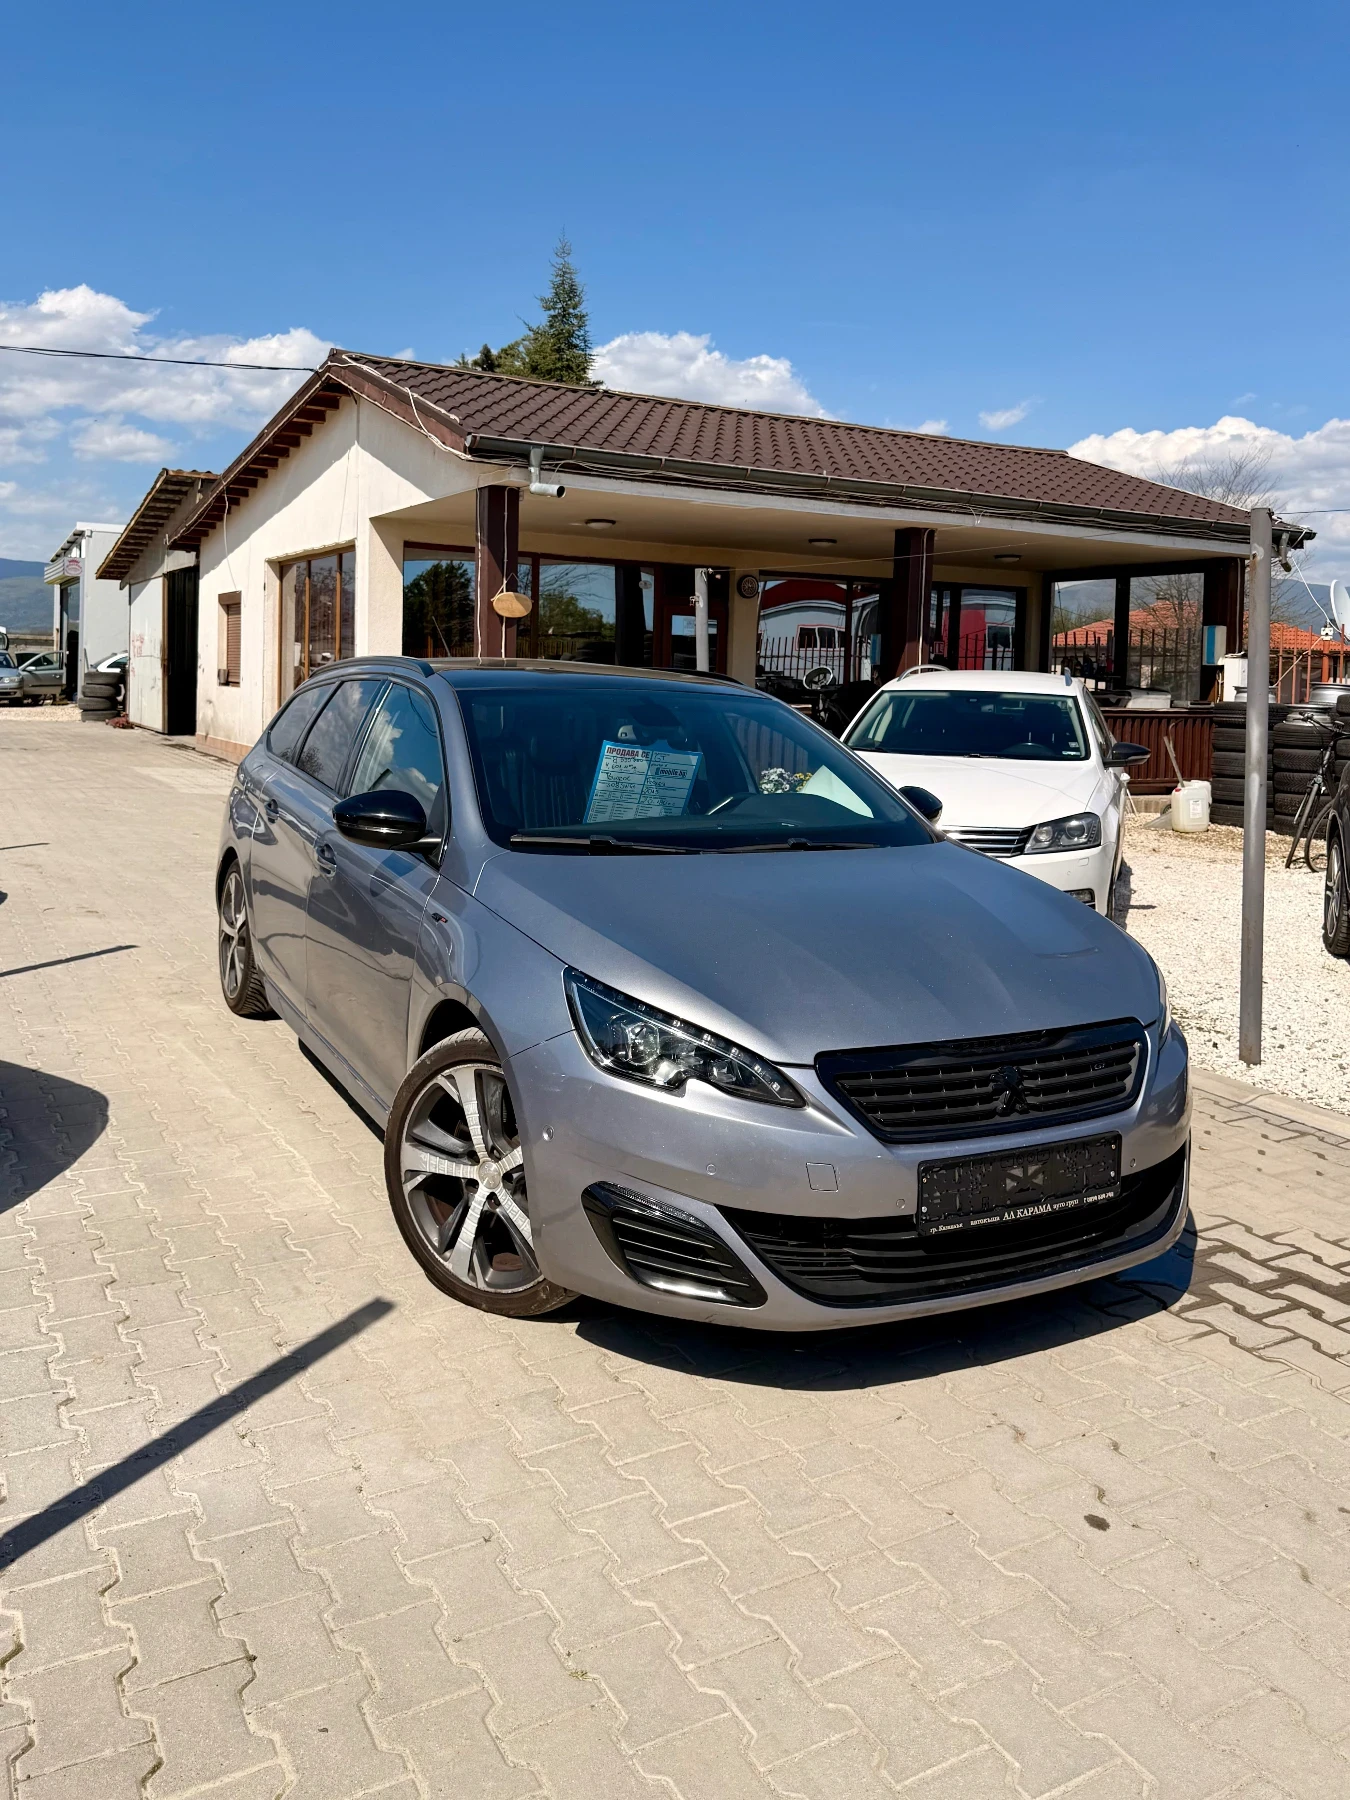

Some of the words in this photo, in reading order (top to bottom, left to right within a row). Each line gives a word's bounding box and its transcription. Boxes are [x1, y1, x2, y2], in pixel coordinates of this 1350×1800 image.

[606, 747, 639, 757] ПРОДАВА
[640, 751, 651, 759] СЕ
[1002, 1210, 1015, 1221] АЛ
[1016, 1203, 1052, 1218] КАРАМА
